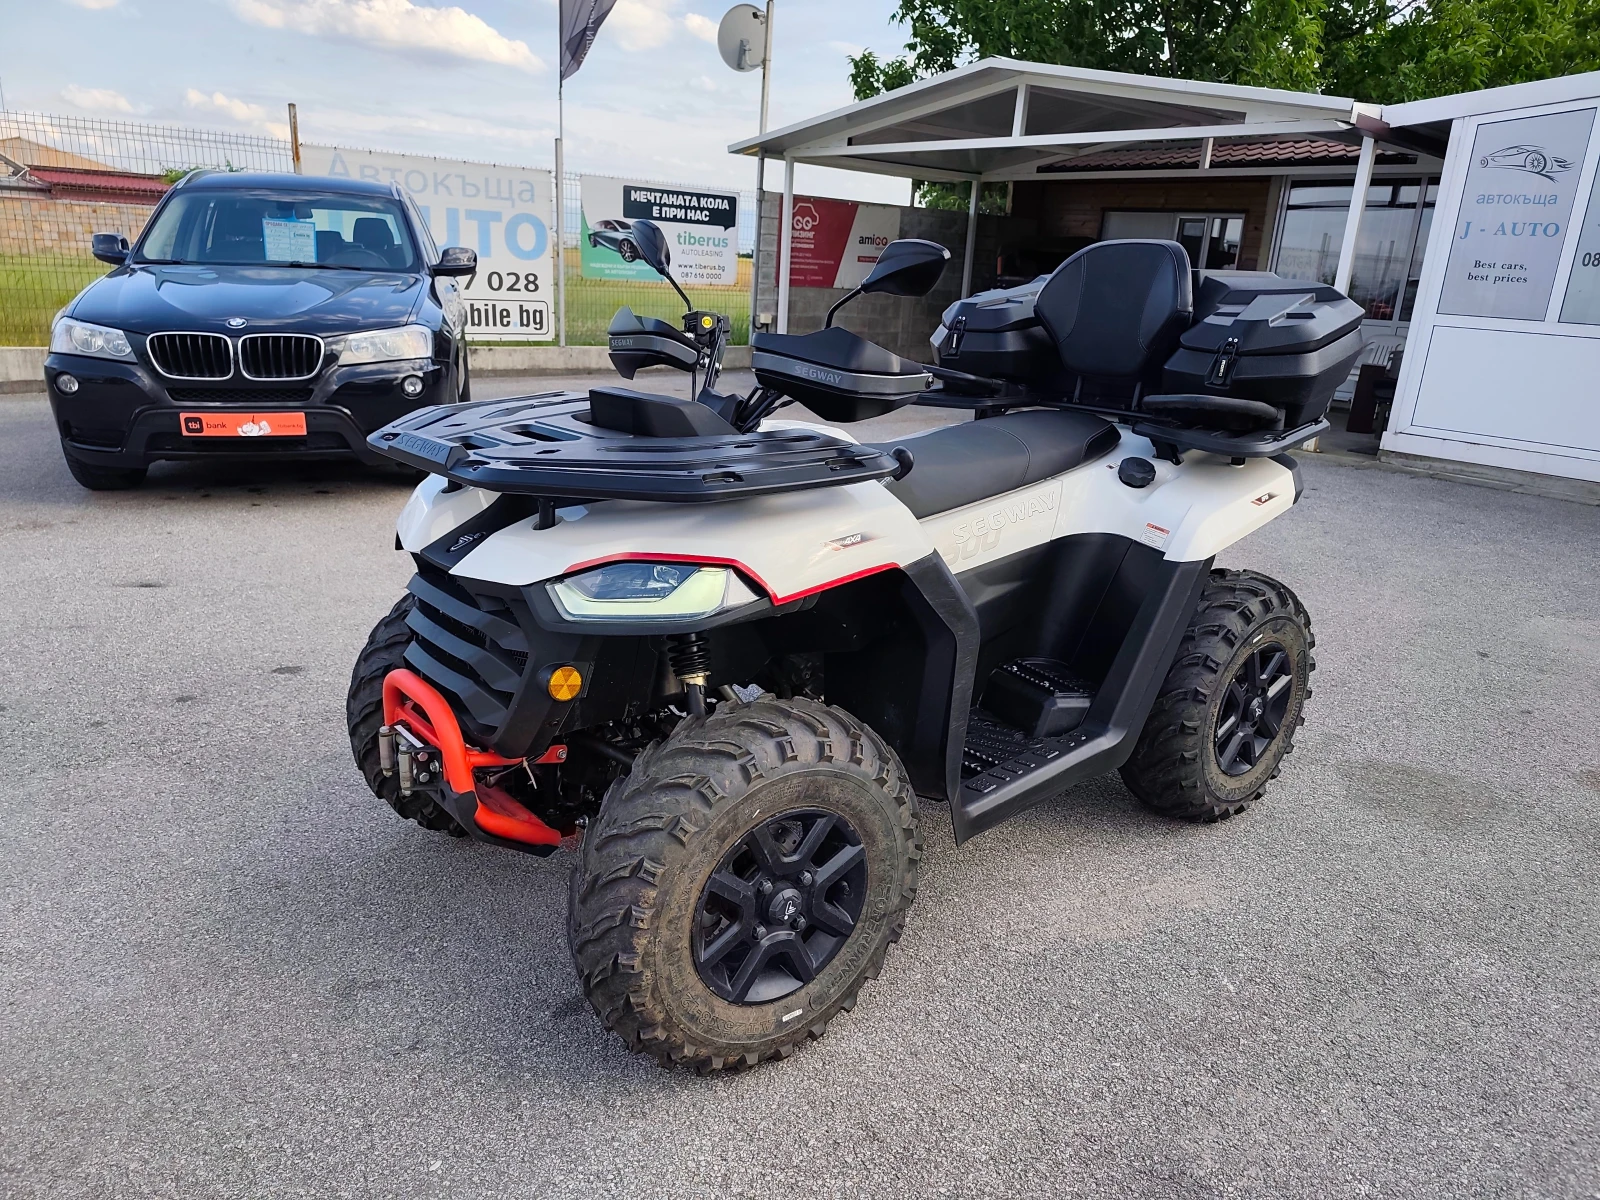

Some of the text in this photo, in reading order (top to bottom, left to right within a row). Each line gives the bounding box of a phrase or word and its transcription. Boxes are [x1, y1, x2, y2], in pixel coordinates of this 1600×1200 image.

[631, 189, 730, 211] МЕЧТАНАТА КОЛА
[1476, 192, 1558, 206] автокъща
[652, 206, 710, 221] Е ПРИ НАС
[1460, 221, 1472, 240] J
[1493, 222, 1560, 238] AUTO
[676, 231, 728, 248] tiberus
[681, 248, 723, 258] AUTOLEASING
[678, 262, 726, 272] www.tiberus.bg
[1474, 259, 1528, 272] Best cars,
[487, 271, 539, 293] 028
[1467, 271, 1528, 286] best prices
[465, 303, 543, 331] bile.bg
[611, 338, 634, 347] SEGWAY
[793, 364, 842, 384] SEGWAY
[187, 421, 228, 429] tbi bank
[397, 434, 447, 457] SEGWAY
[952, 490, 1055, 545] SEGWAY
